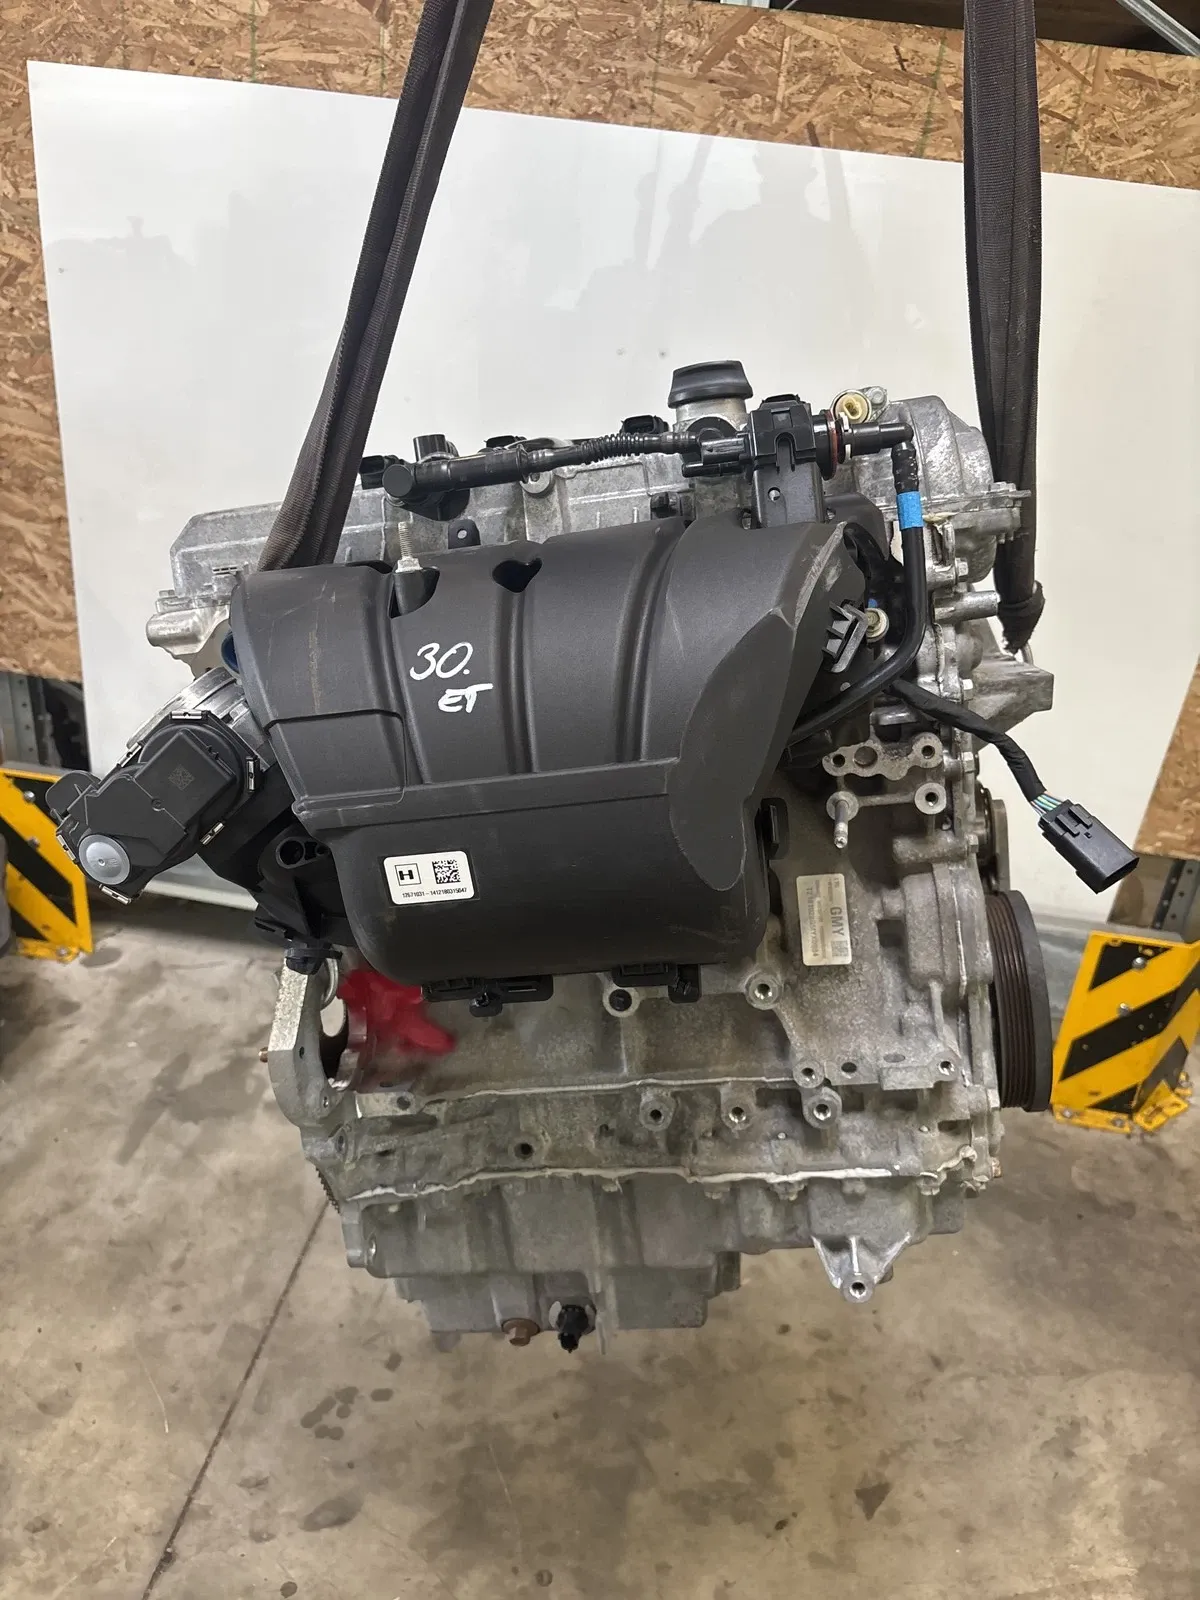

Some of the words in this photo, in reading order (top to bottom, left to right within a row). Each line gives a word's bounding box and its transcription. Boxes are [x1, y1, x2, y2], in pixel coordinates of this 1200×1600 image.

[409, 641, 474, 681] 30.
[437, 682, 494, 714] ET
[398, 869, 415, 881] H
[829, 906, 845, 937] GMY
